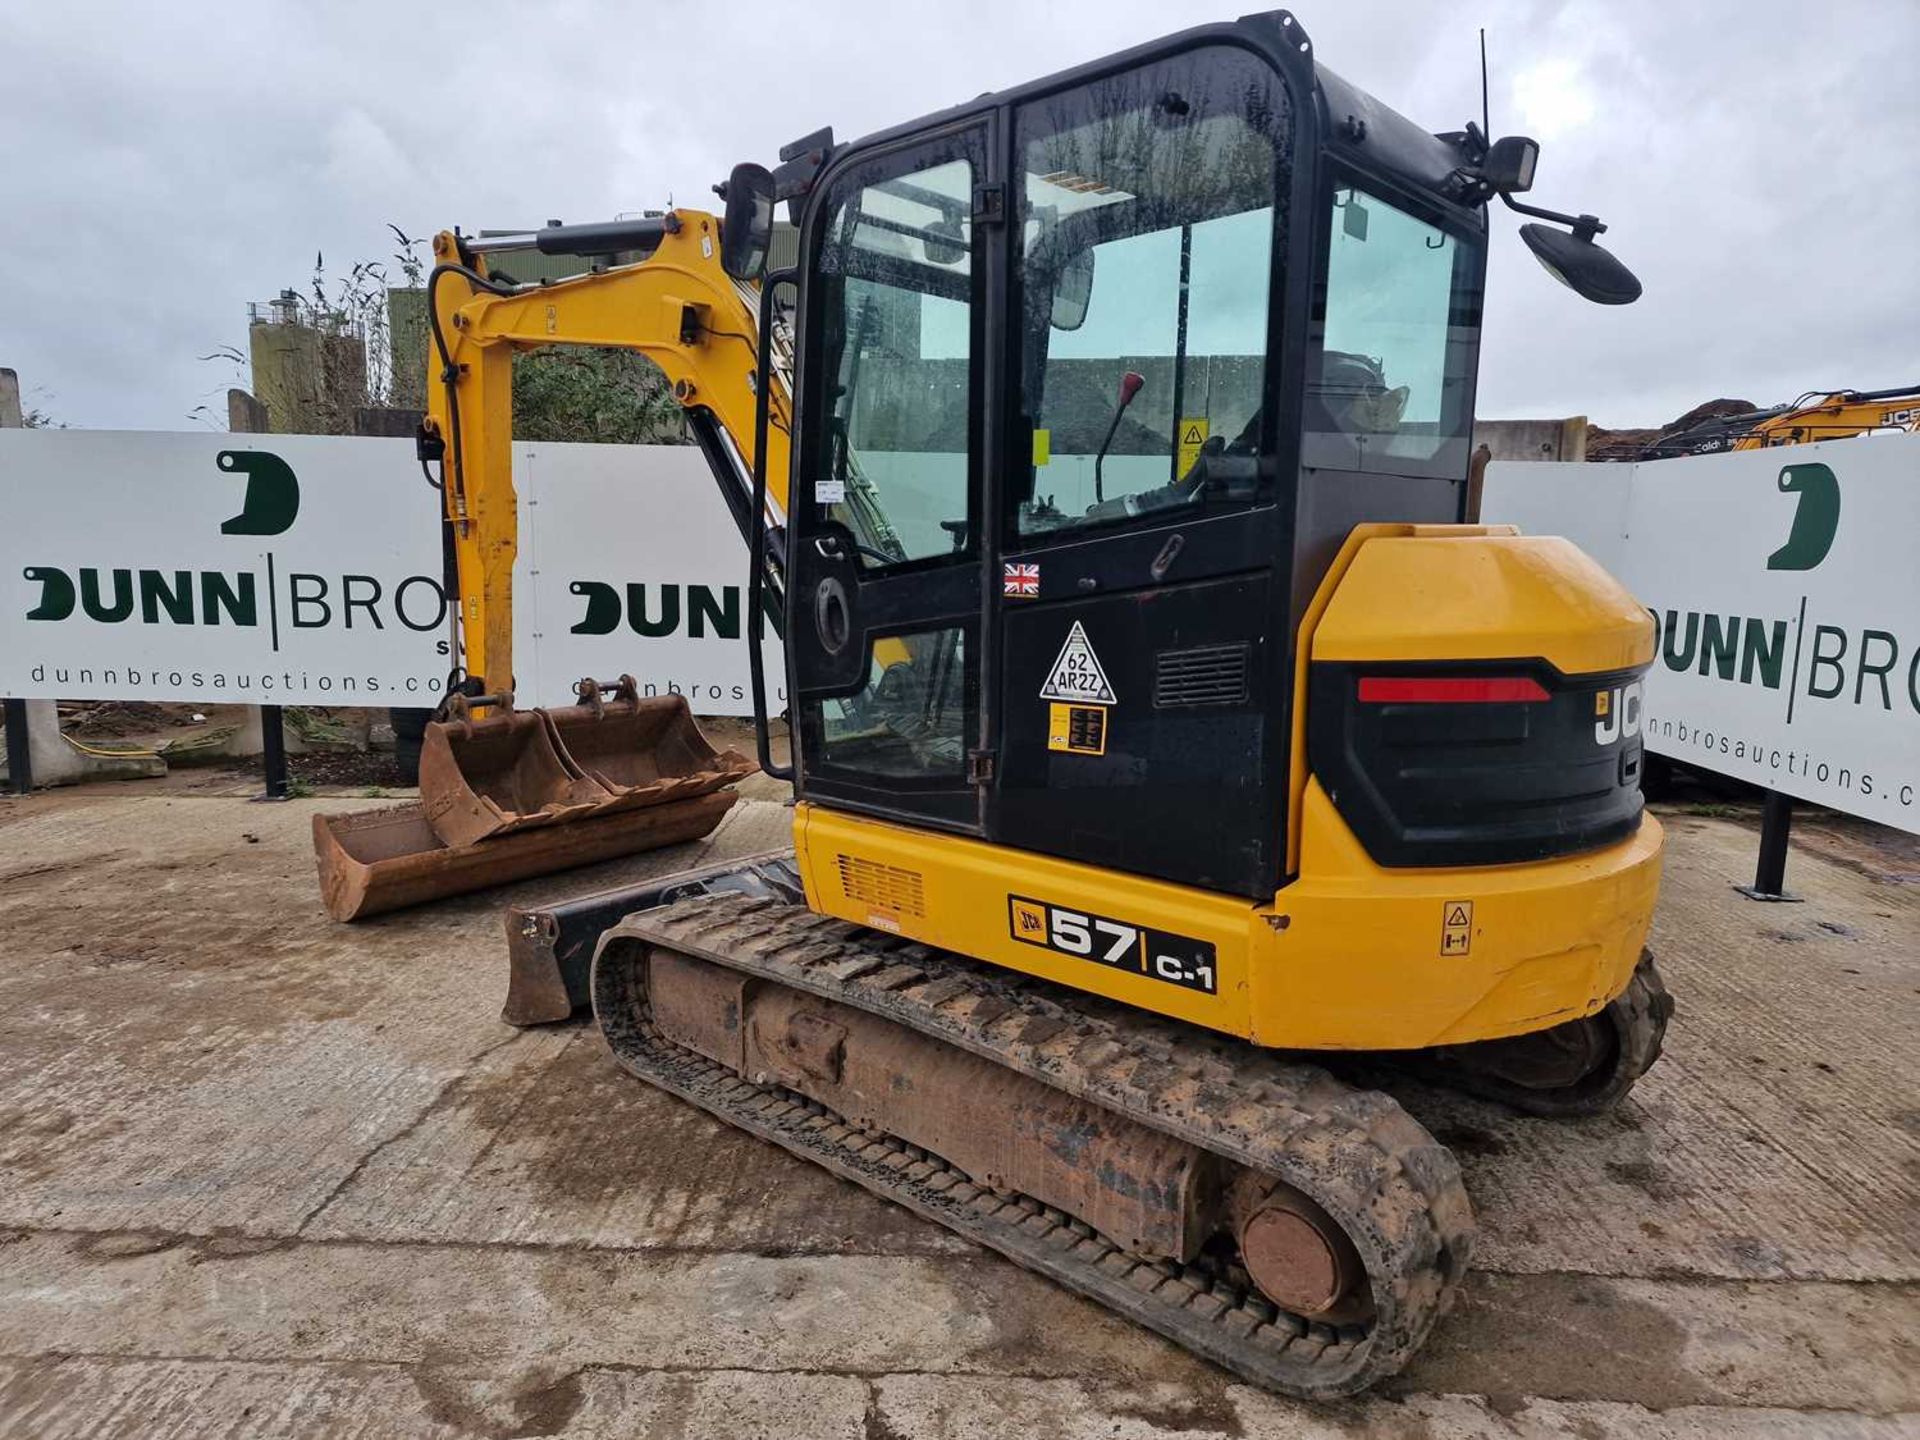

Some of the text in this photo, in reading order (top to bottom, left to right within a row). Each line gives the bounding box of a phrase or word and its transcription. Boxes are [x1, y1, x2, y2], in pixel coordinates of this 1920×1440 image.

[23, 566, 258, 627] DUNN
[289, 573, 465, 632] BRO
[1068, 652, 1088, 672] 62
[1648, 607, 1920, 715] UNN BR
[1051, 908, 1137, 963] 57
[1156, 954, 1213, 990] C-1
